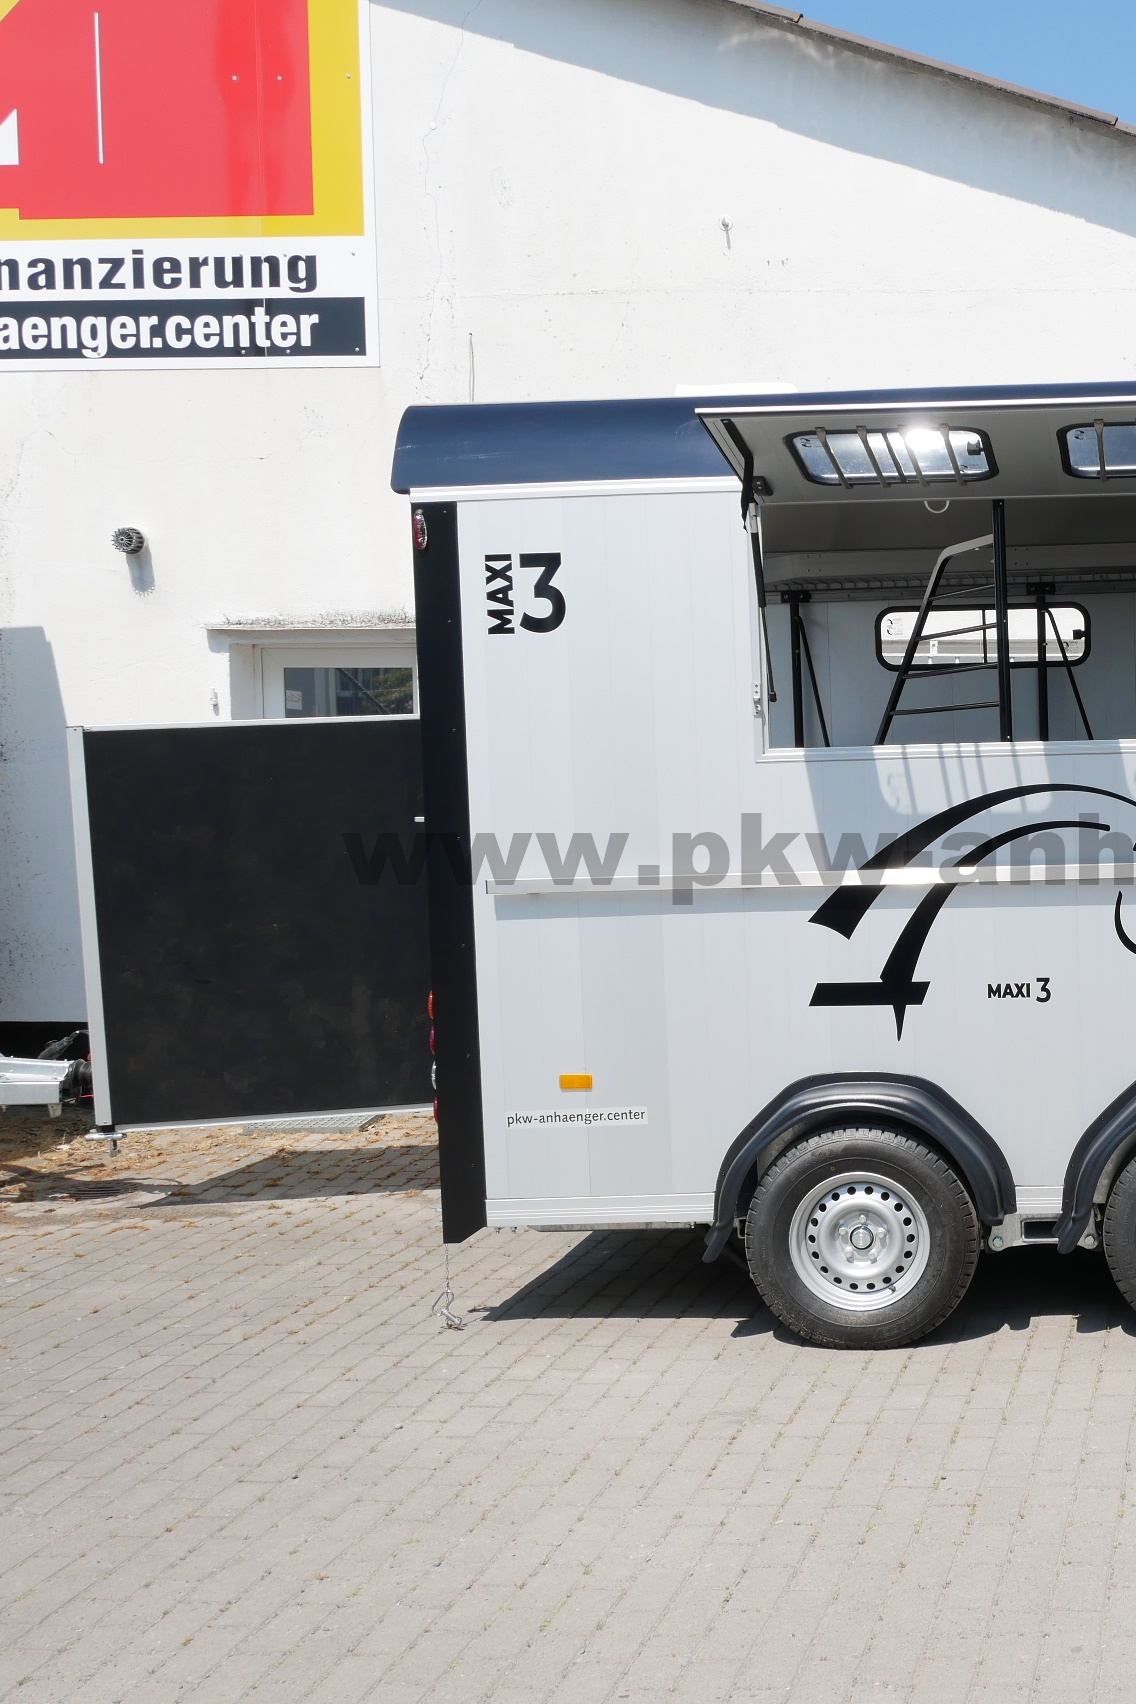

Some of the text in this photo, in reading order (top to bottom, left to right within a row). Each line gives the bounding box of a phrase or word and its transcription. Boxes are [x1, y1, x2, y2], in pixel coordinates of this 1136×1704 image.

[0, 249, 317, 293] nanzierung
[0, 307, 319, 358] aenger.center
[485, 553, 515, 635] MAXI
[519, 552, 566, 634] 3
[987, 977, 1052, 1003] MAXI 3
[507, 1109, 646, 1127] pkw-anhaenger.center
